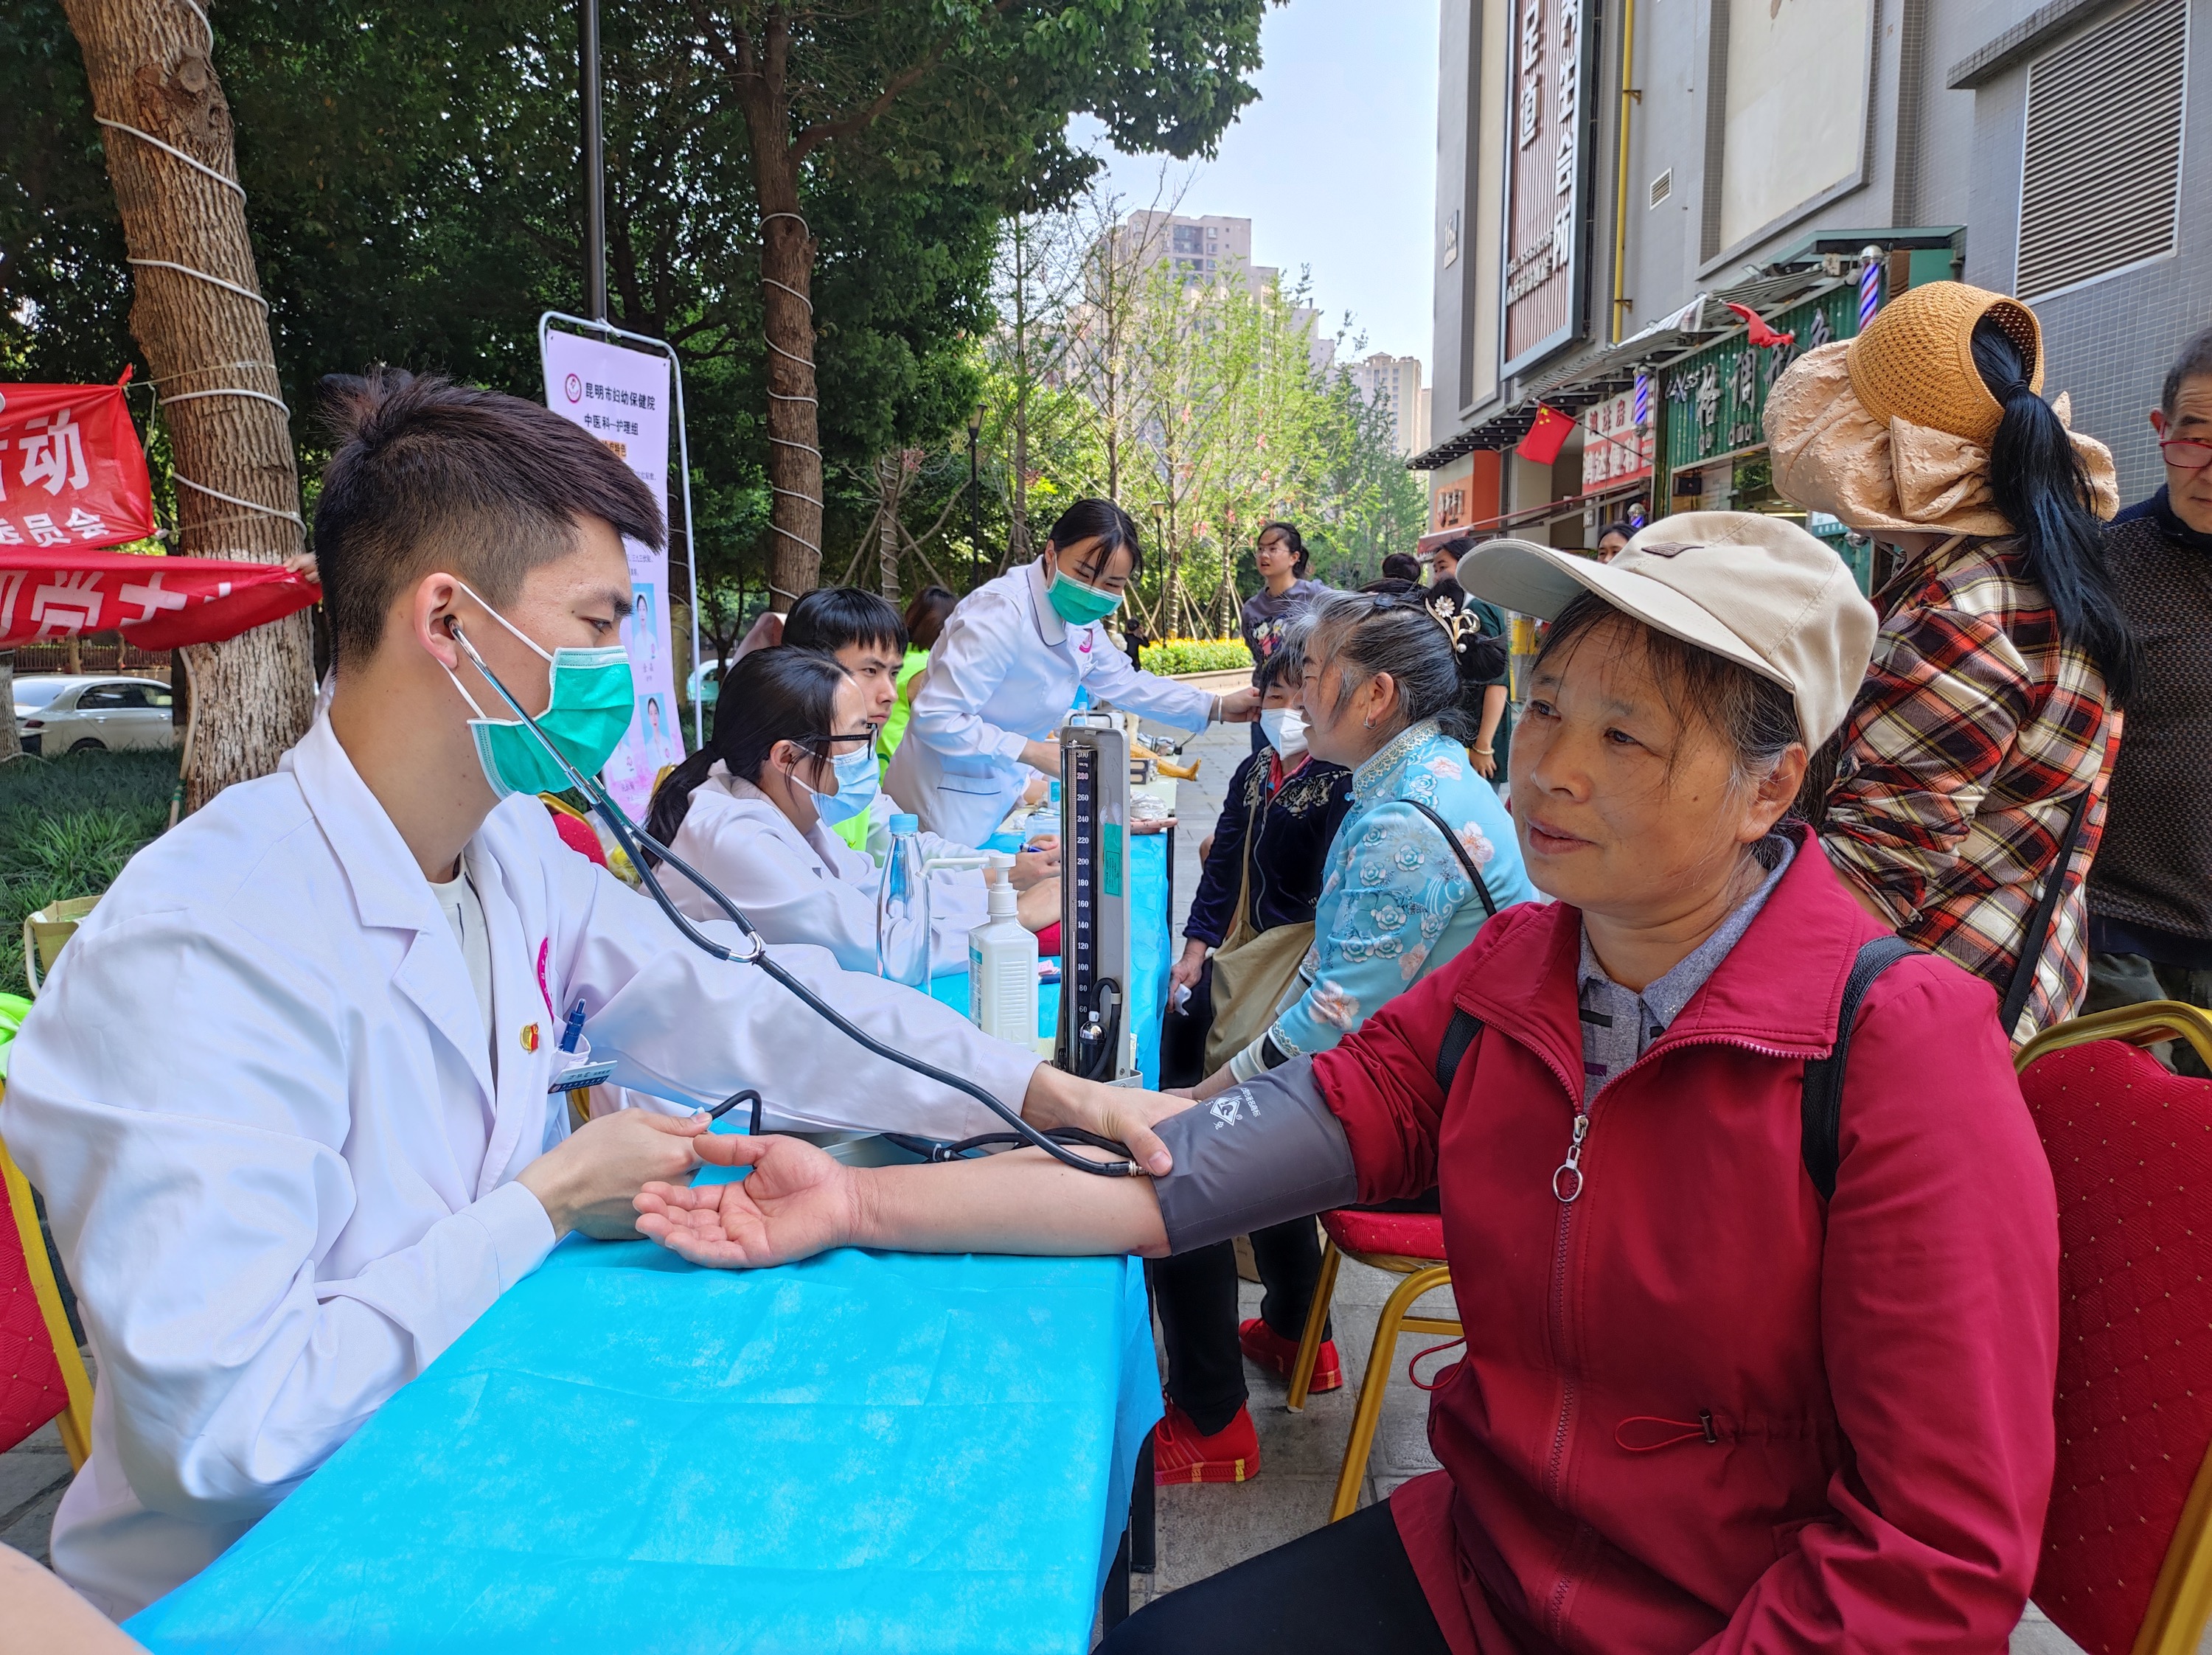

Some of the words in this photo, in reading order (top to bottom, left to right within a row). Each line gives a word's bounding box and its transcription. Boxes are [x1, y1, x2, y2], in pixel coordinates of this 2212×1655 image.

[585, 383, 655, 411] 昆明市妇幼保健院
[0, 408, 89, 502] 动
[1077, 772, 1089, 780] 280
